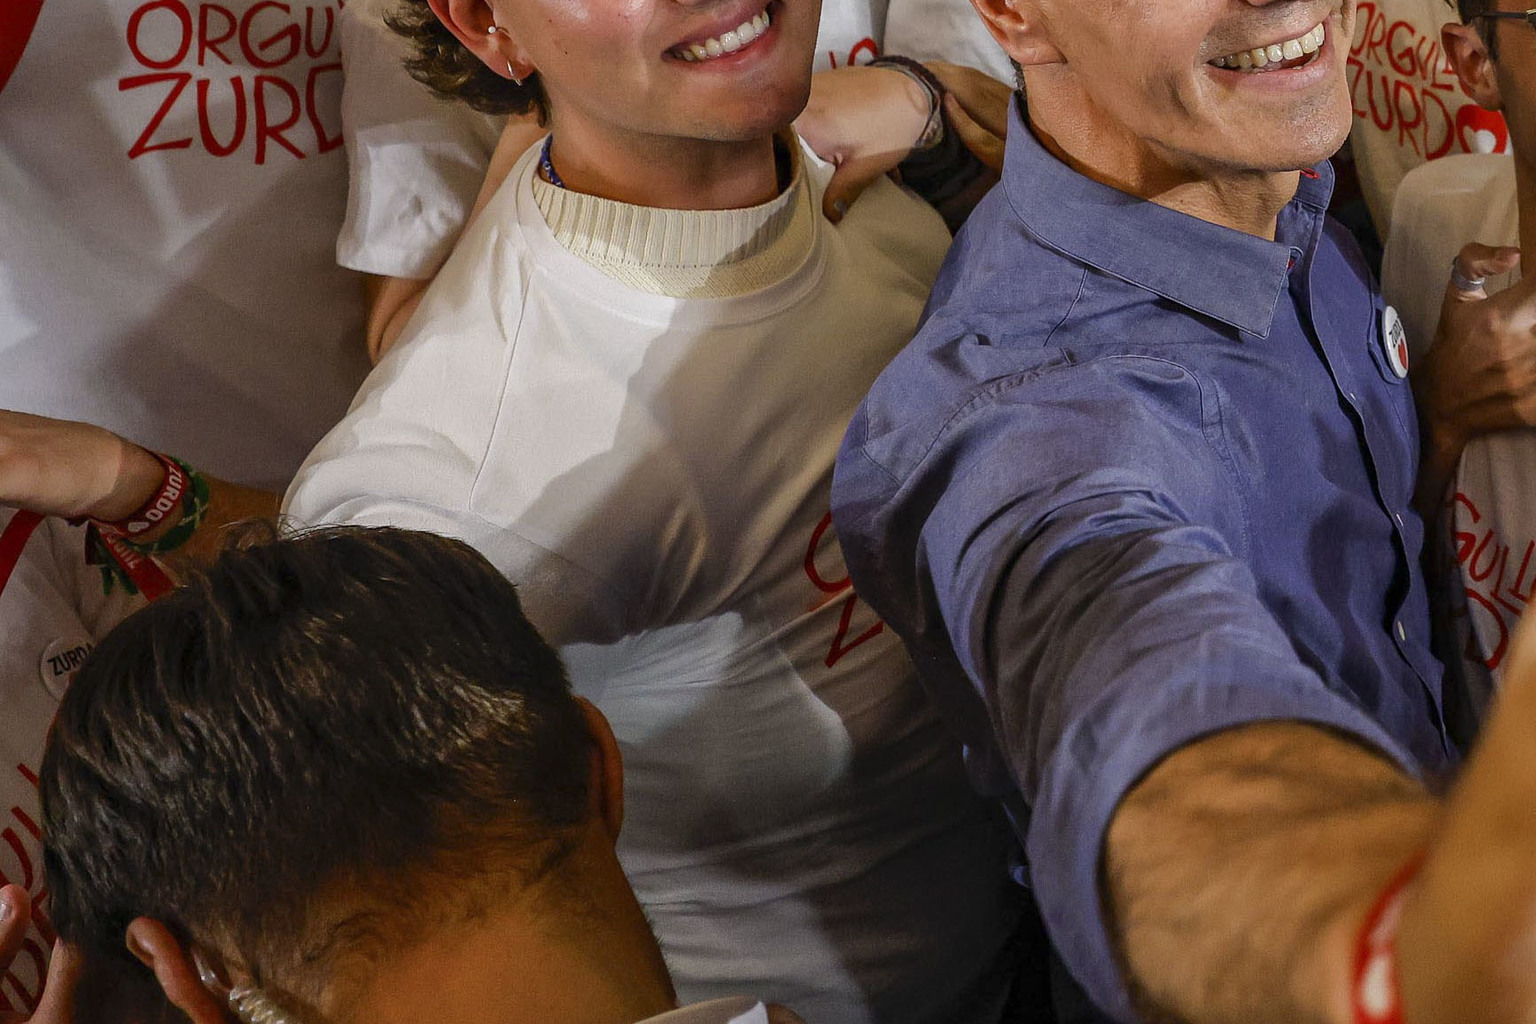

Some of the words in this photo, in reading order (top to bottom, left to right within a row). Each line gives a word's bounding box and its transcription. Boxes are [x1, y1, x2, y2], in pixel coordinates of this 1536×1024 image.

[118, 63, 344, 165] ZURD
[145, 466, 183, 522] ZURDO
[47, 643, 92, 676] ZURD
